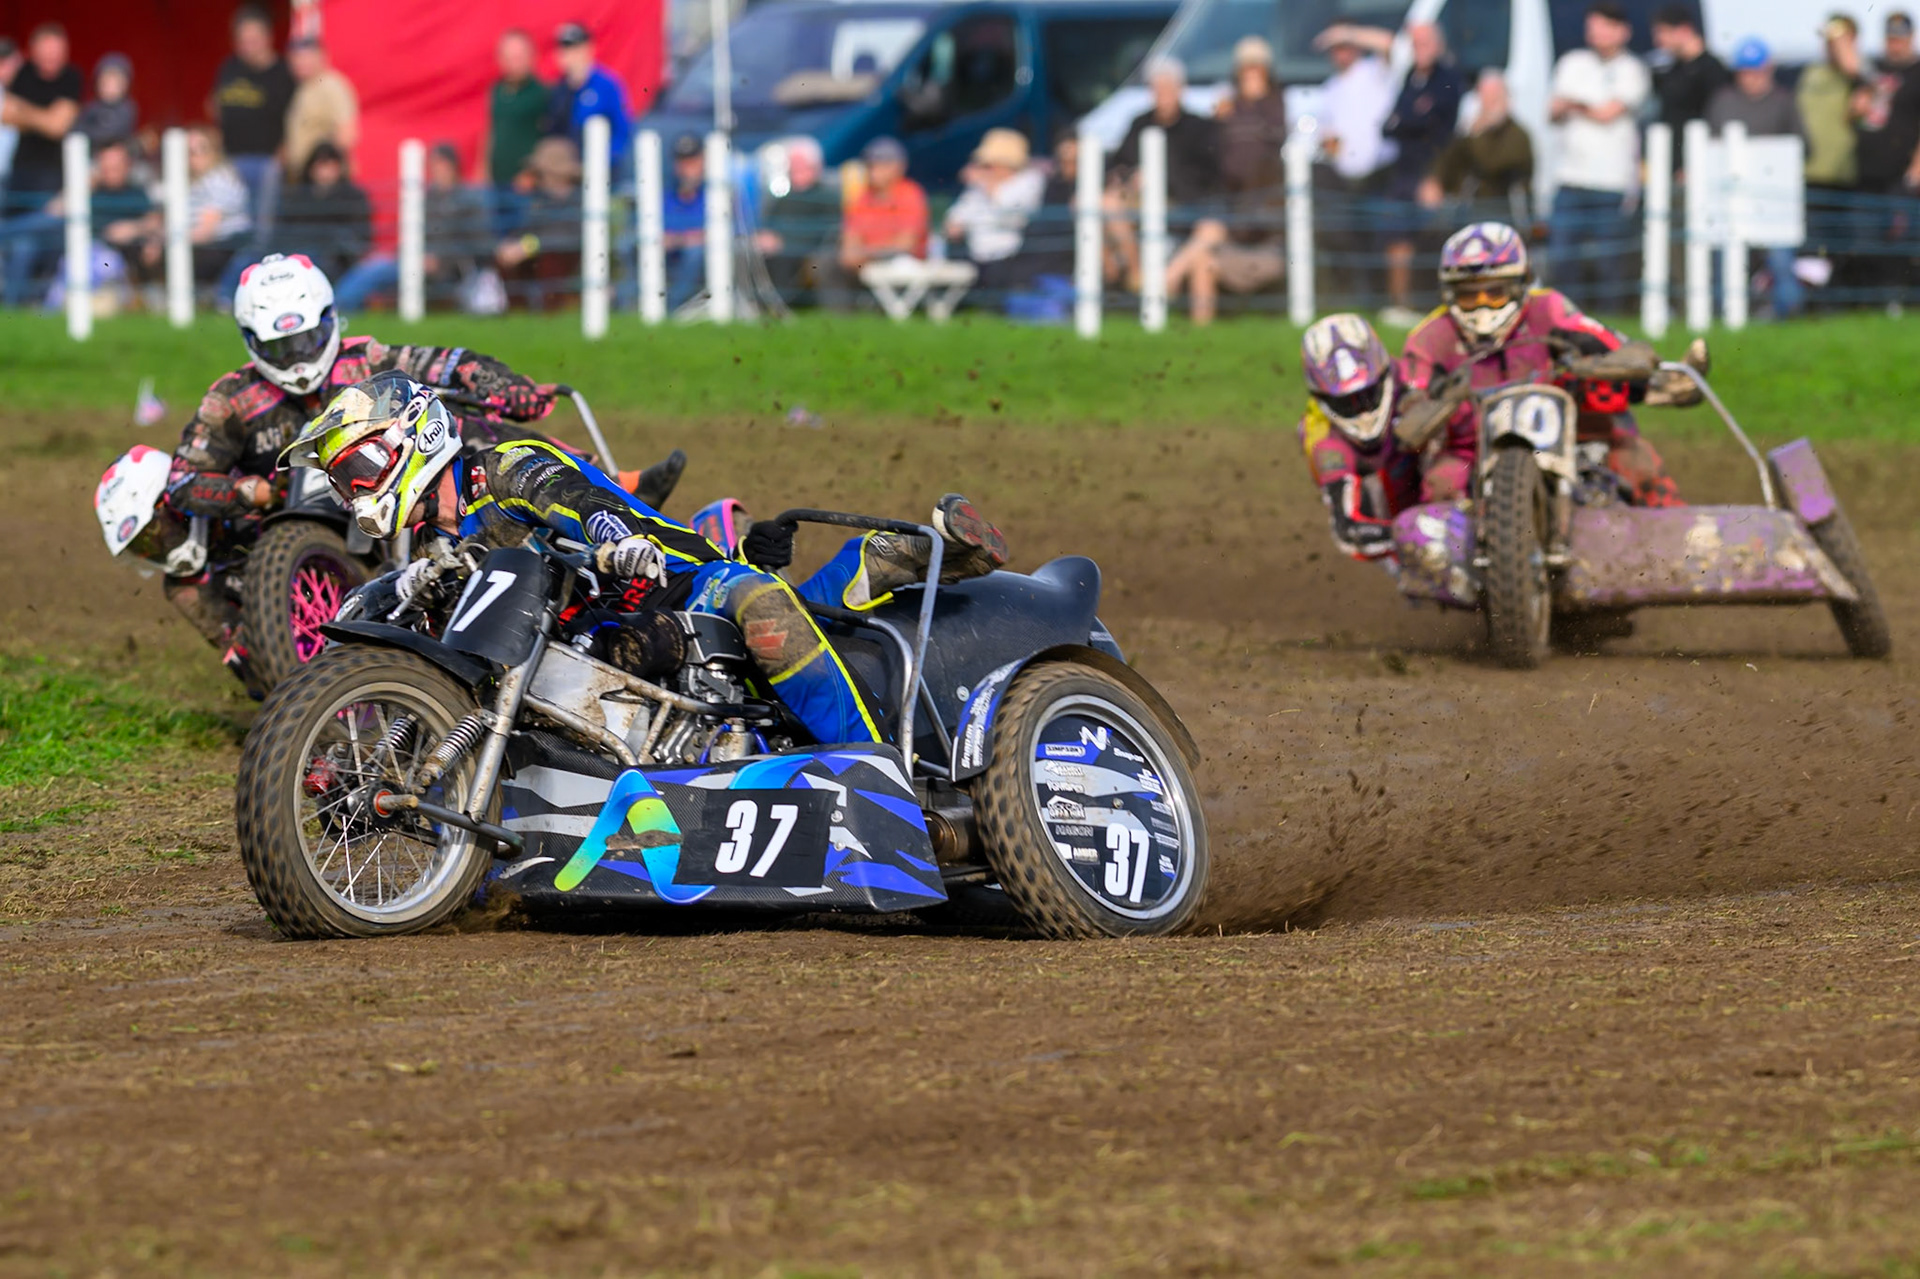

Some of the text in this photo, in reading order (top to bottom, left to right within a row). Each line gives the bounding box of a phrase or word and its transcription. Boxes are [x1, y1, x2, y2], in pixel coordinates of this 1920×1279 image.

[421, 420, 445, 452] Arai
[714, 799, 799, 878] 37
[1104, 823, 1150, 903] 37
